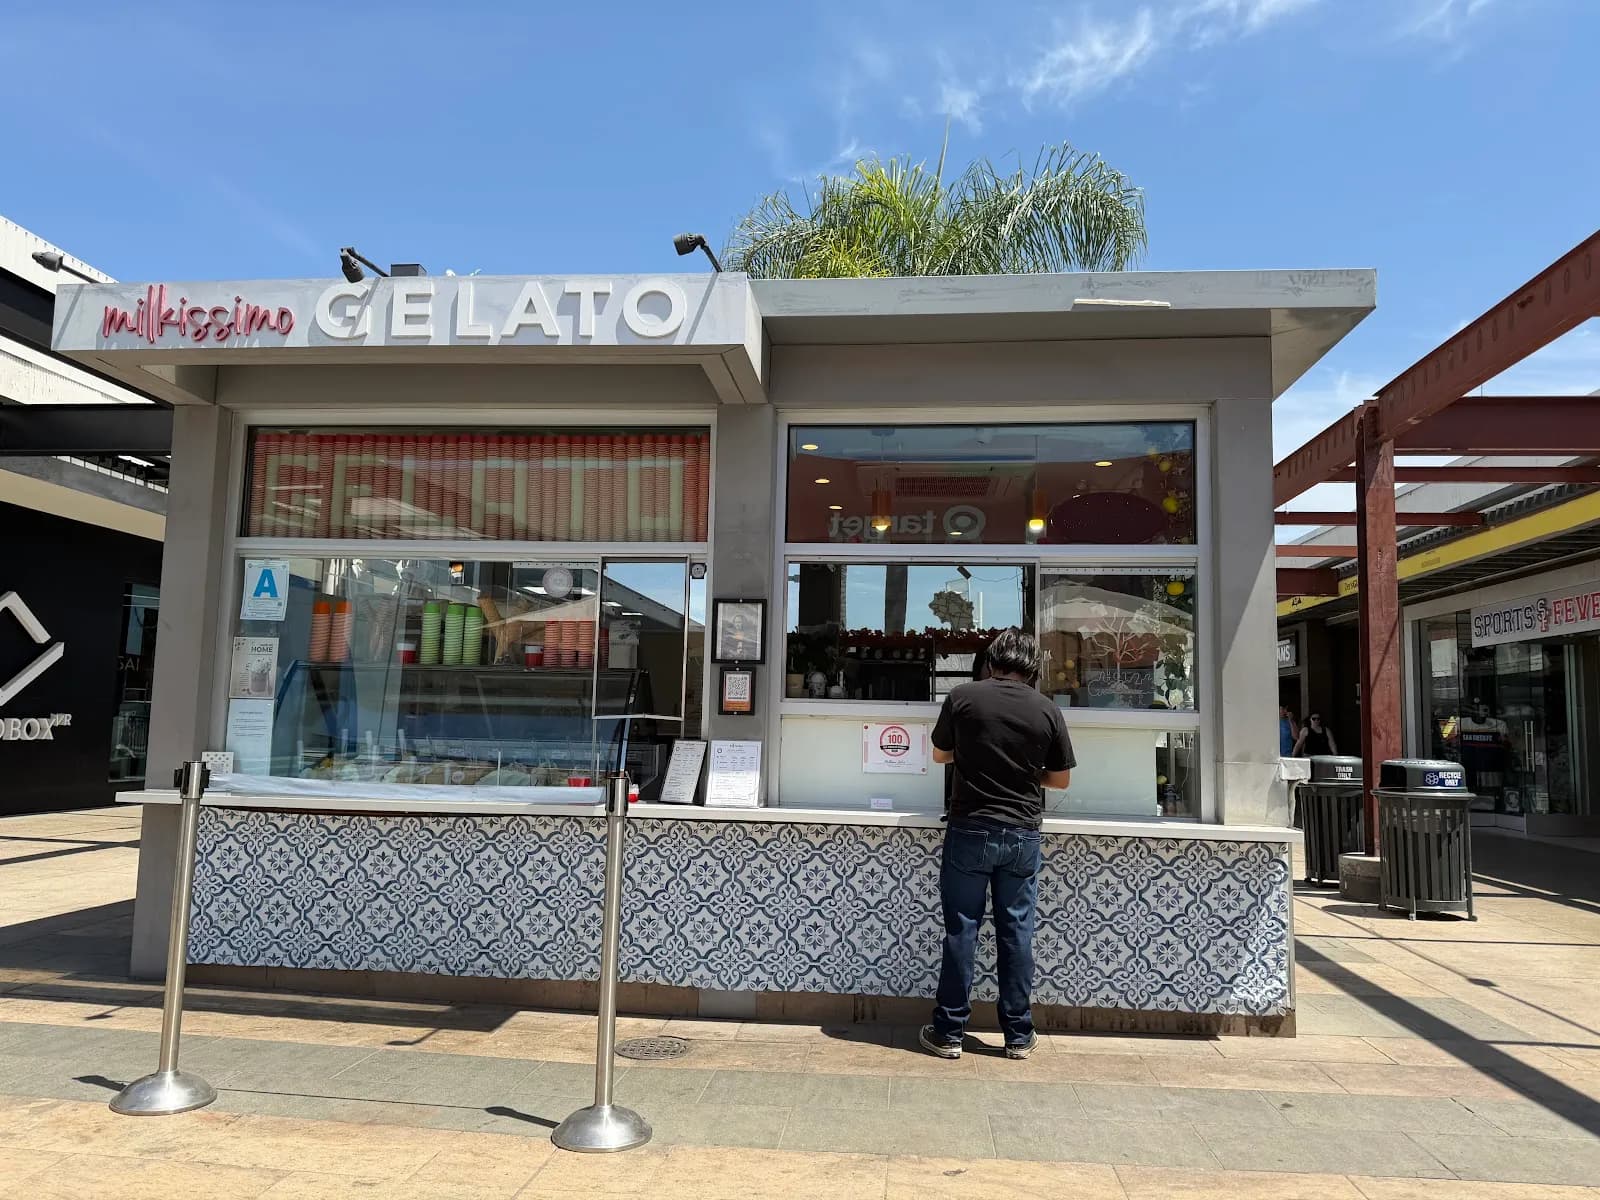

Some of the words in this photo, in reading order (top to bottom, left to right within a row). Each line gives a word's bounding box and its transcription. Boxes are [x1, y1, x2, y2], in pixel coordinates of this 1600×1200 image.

[103, 285, 295, 344] milkissimo
[315, 279, 688, 339] GELATO
[252, 568, 279, 598] A
[1474, 606, 1535, 638] SPORTS
[887, 734, 903, 745] 100
